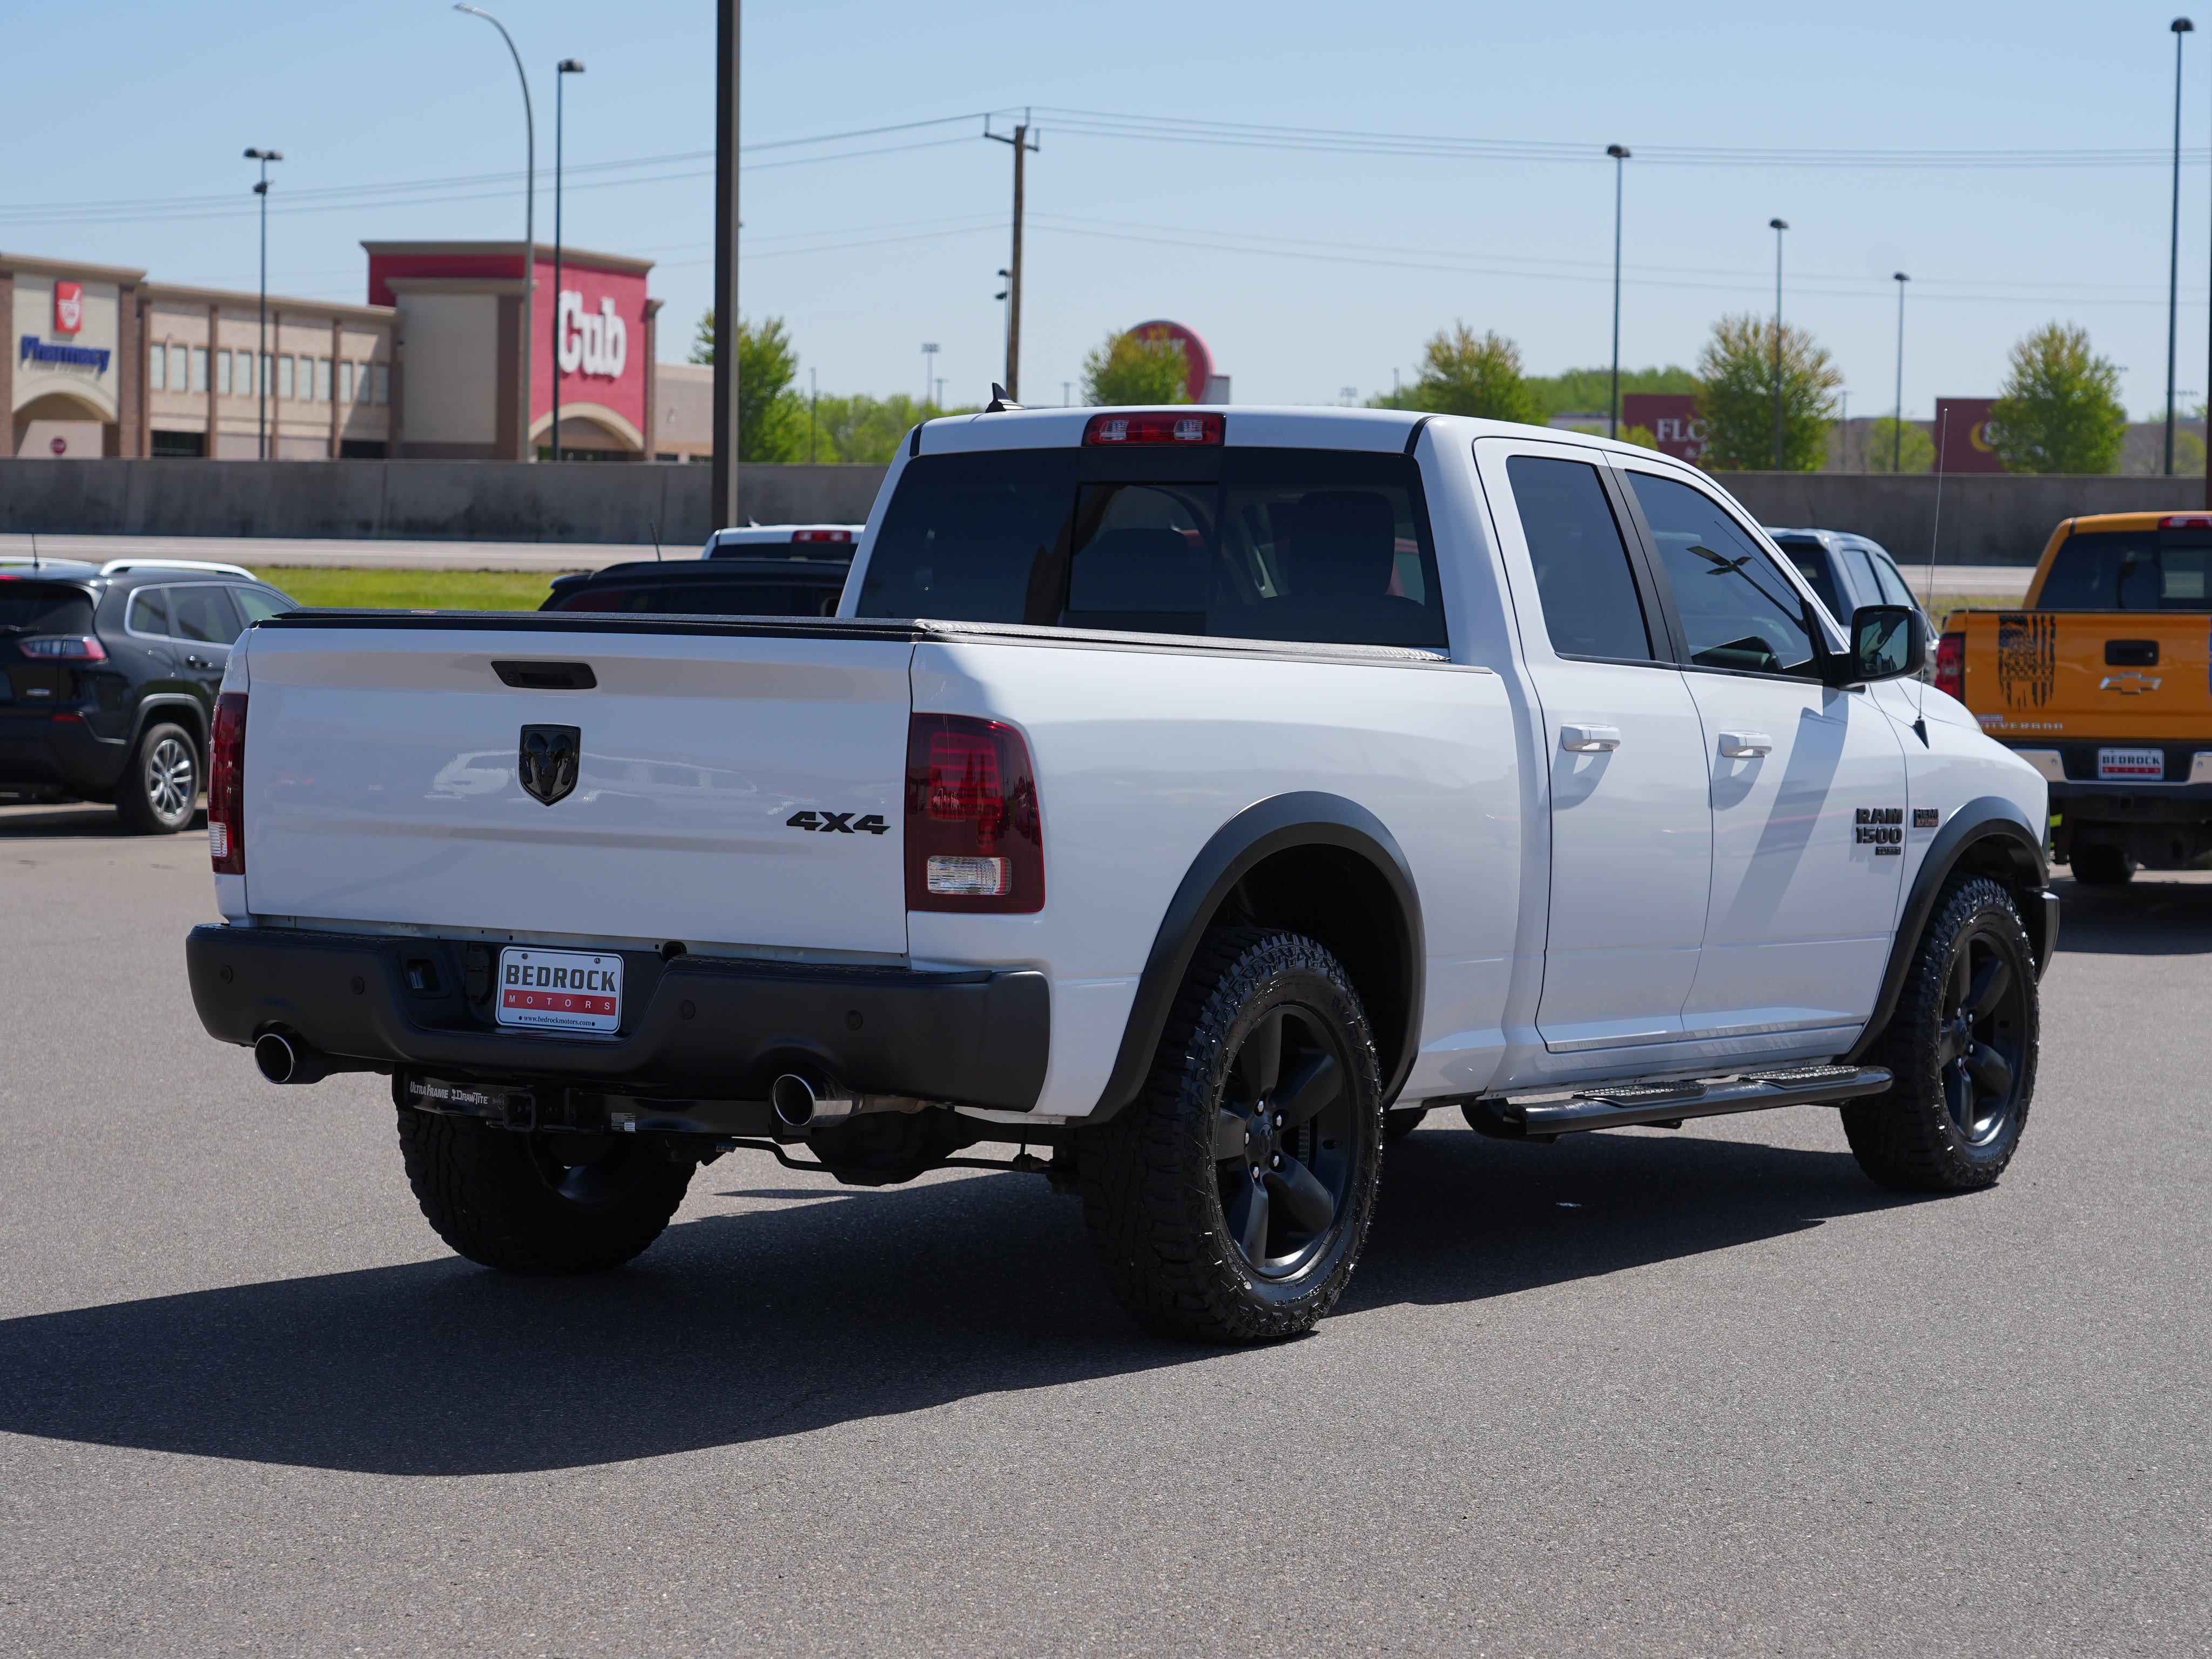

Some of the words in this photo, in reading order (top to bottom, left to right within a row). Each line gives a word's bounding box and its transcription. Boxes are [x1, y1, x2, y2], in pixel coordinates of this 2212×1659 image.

[558, 290, 627, 378] Cub
[21, 336, 111, 373] Pharmacy
[2102, 756, 2160, 764] BEDROCK
[1856, 808, 1903, 824] RAM
[1917, 808, 1939, 819] HEMI
[786, 811, 891, 834] 4X4
[1856, 826, 1903, 844] 1500
[505, 964, 616, 992] BEDROCK
[509, 994, 610, 1010] MOTORS
[524, 1015, 591, 1027] www.bedrockmotors.com
